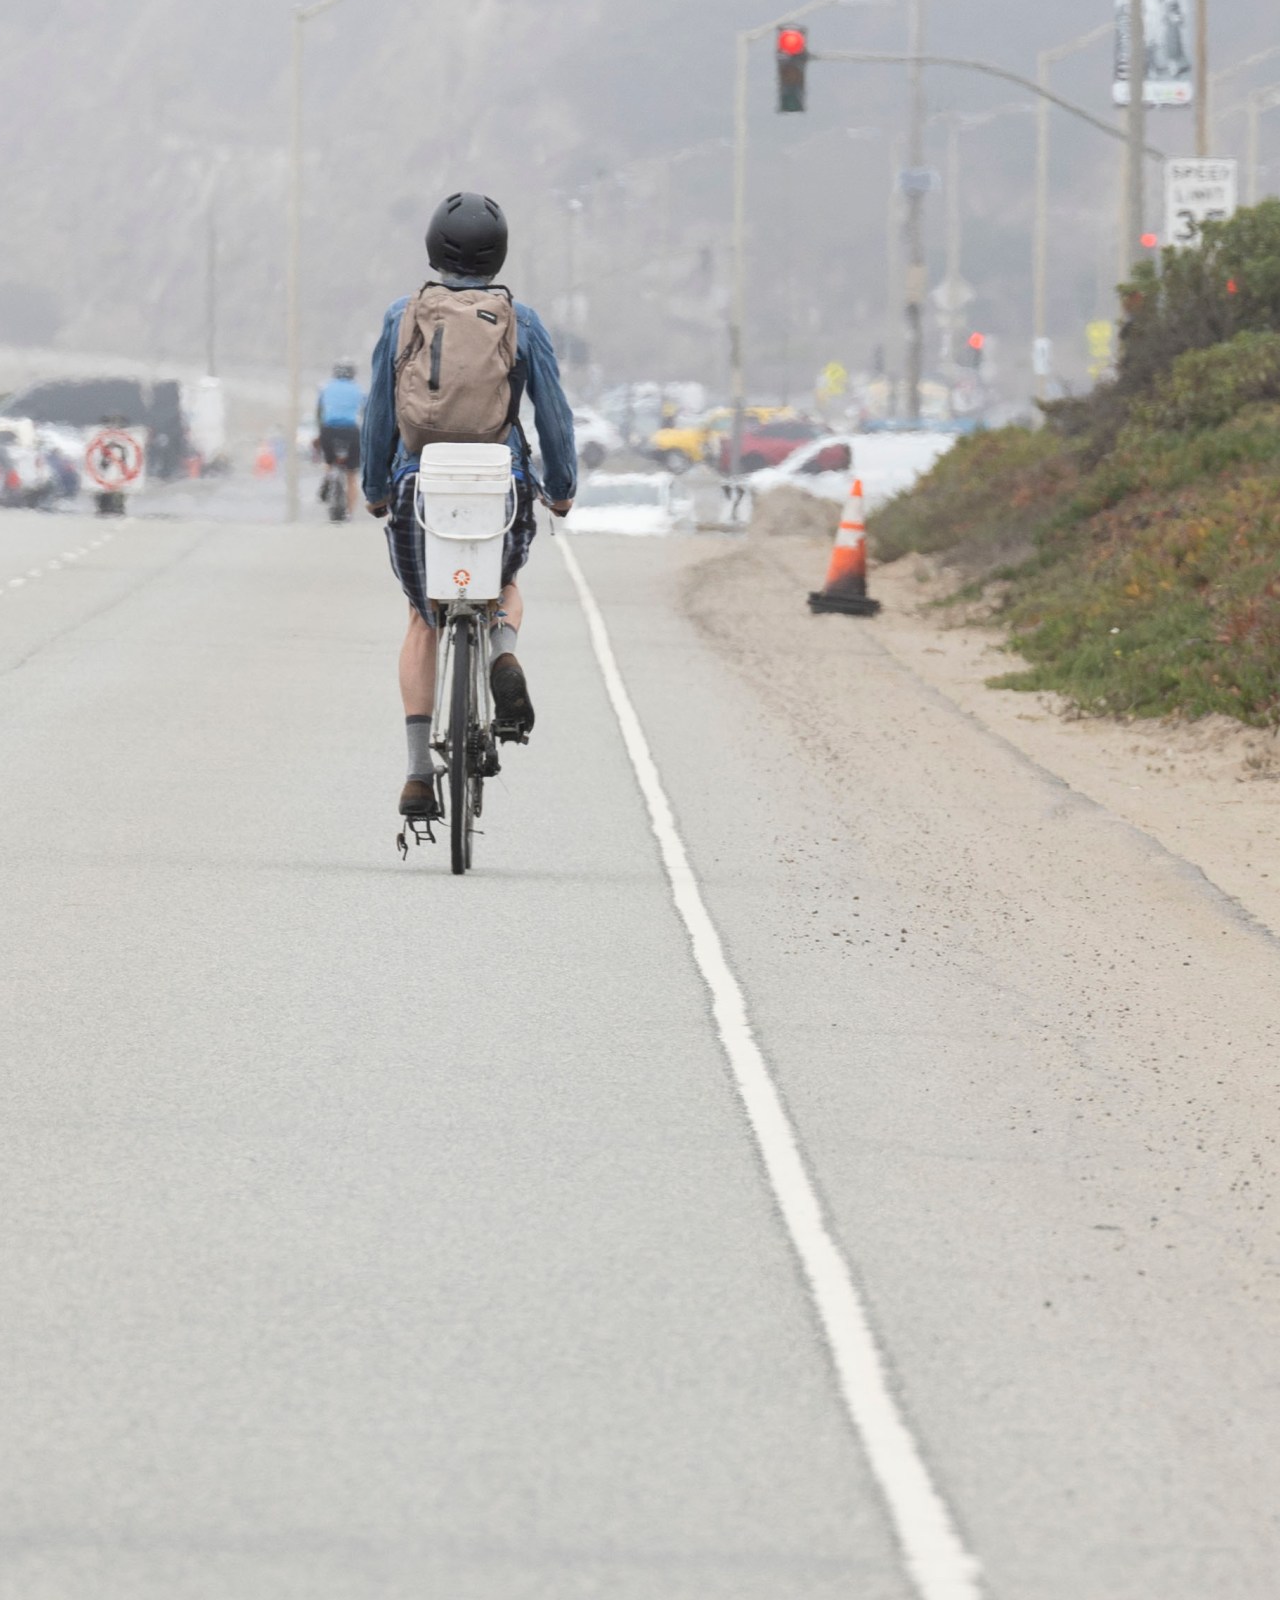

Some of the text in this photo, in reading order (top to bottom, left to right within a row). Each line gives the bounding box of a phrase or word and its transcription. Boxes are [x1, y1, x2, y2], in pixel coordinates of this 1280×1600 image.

[1172, 165, 1230, 181] SPEED
[1175, 186, 1225, 202] LIMIT
[1176, 208, 1226, 241] 3
